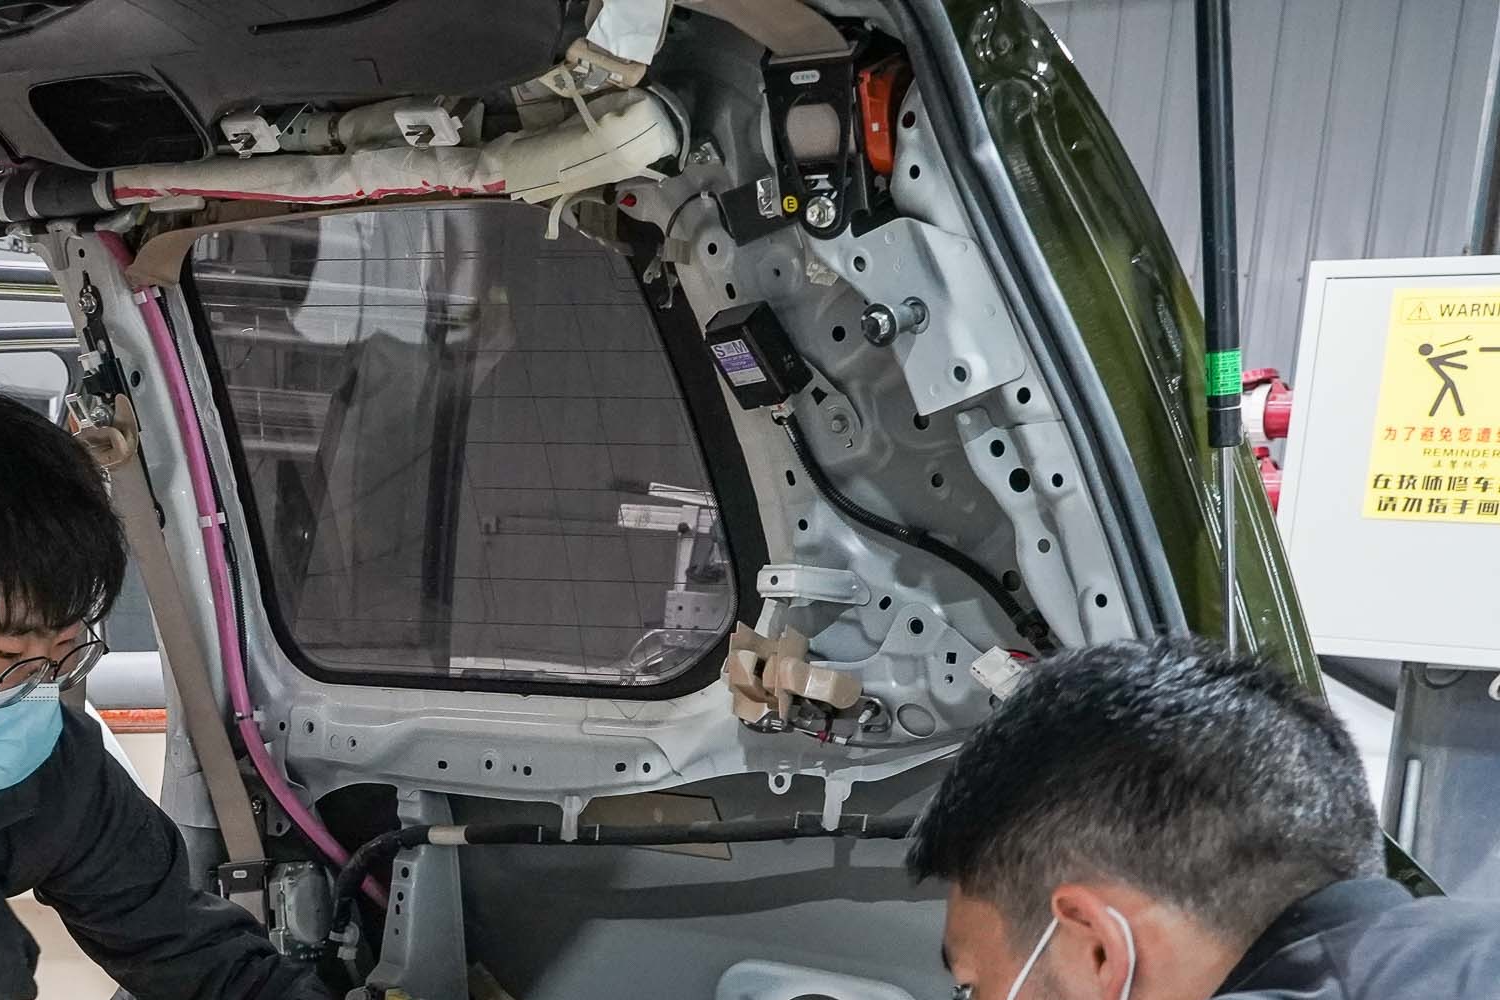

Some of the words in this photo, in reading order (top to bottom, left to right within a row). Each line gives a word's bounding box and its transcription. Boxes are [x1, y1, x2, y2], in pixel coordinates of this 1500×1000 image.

[1373, 473, 1500, 492] 在技师修车
